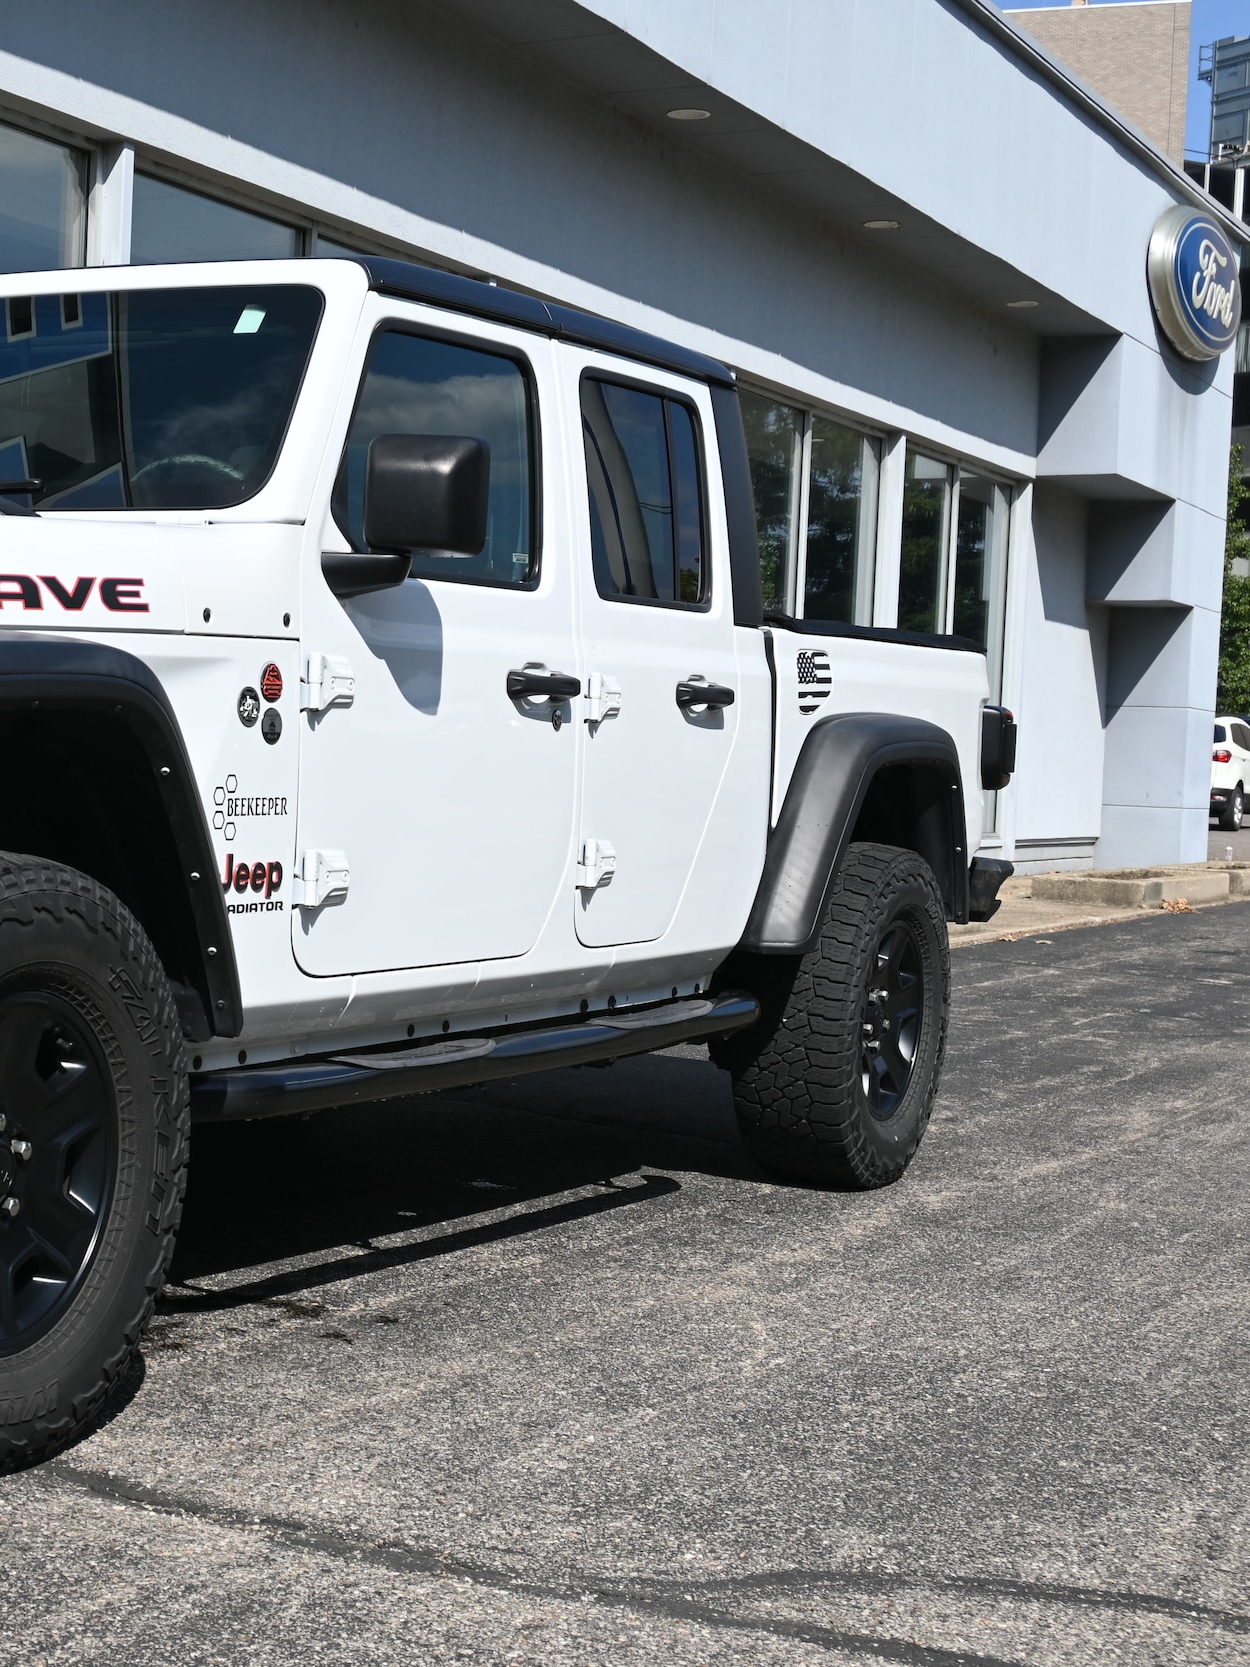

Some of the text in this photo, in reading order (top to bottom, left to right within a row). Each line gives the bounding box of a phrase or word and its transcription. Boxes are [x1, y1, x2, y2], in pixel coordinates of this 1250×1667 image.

[1192, 239, 1236, 328] Ford
[227, 797, 288, 817] BEEKEEPER
[221, 853, 283, 900] Jeep
[227, 901, 284, 914] ADIATOR
